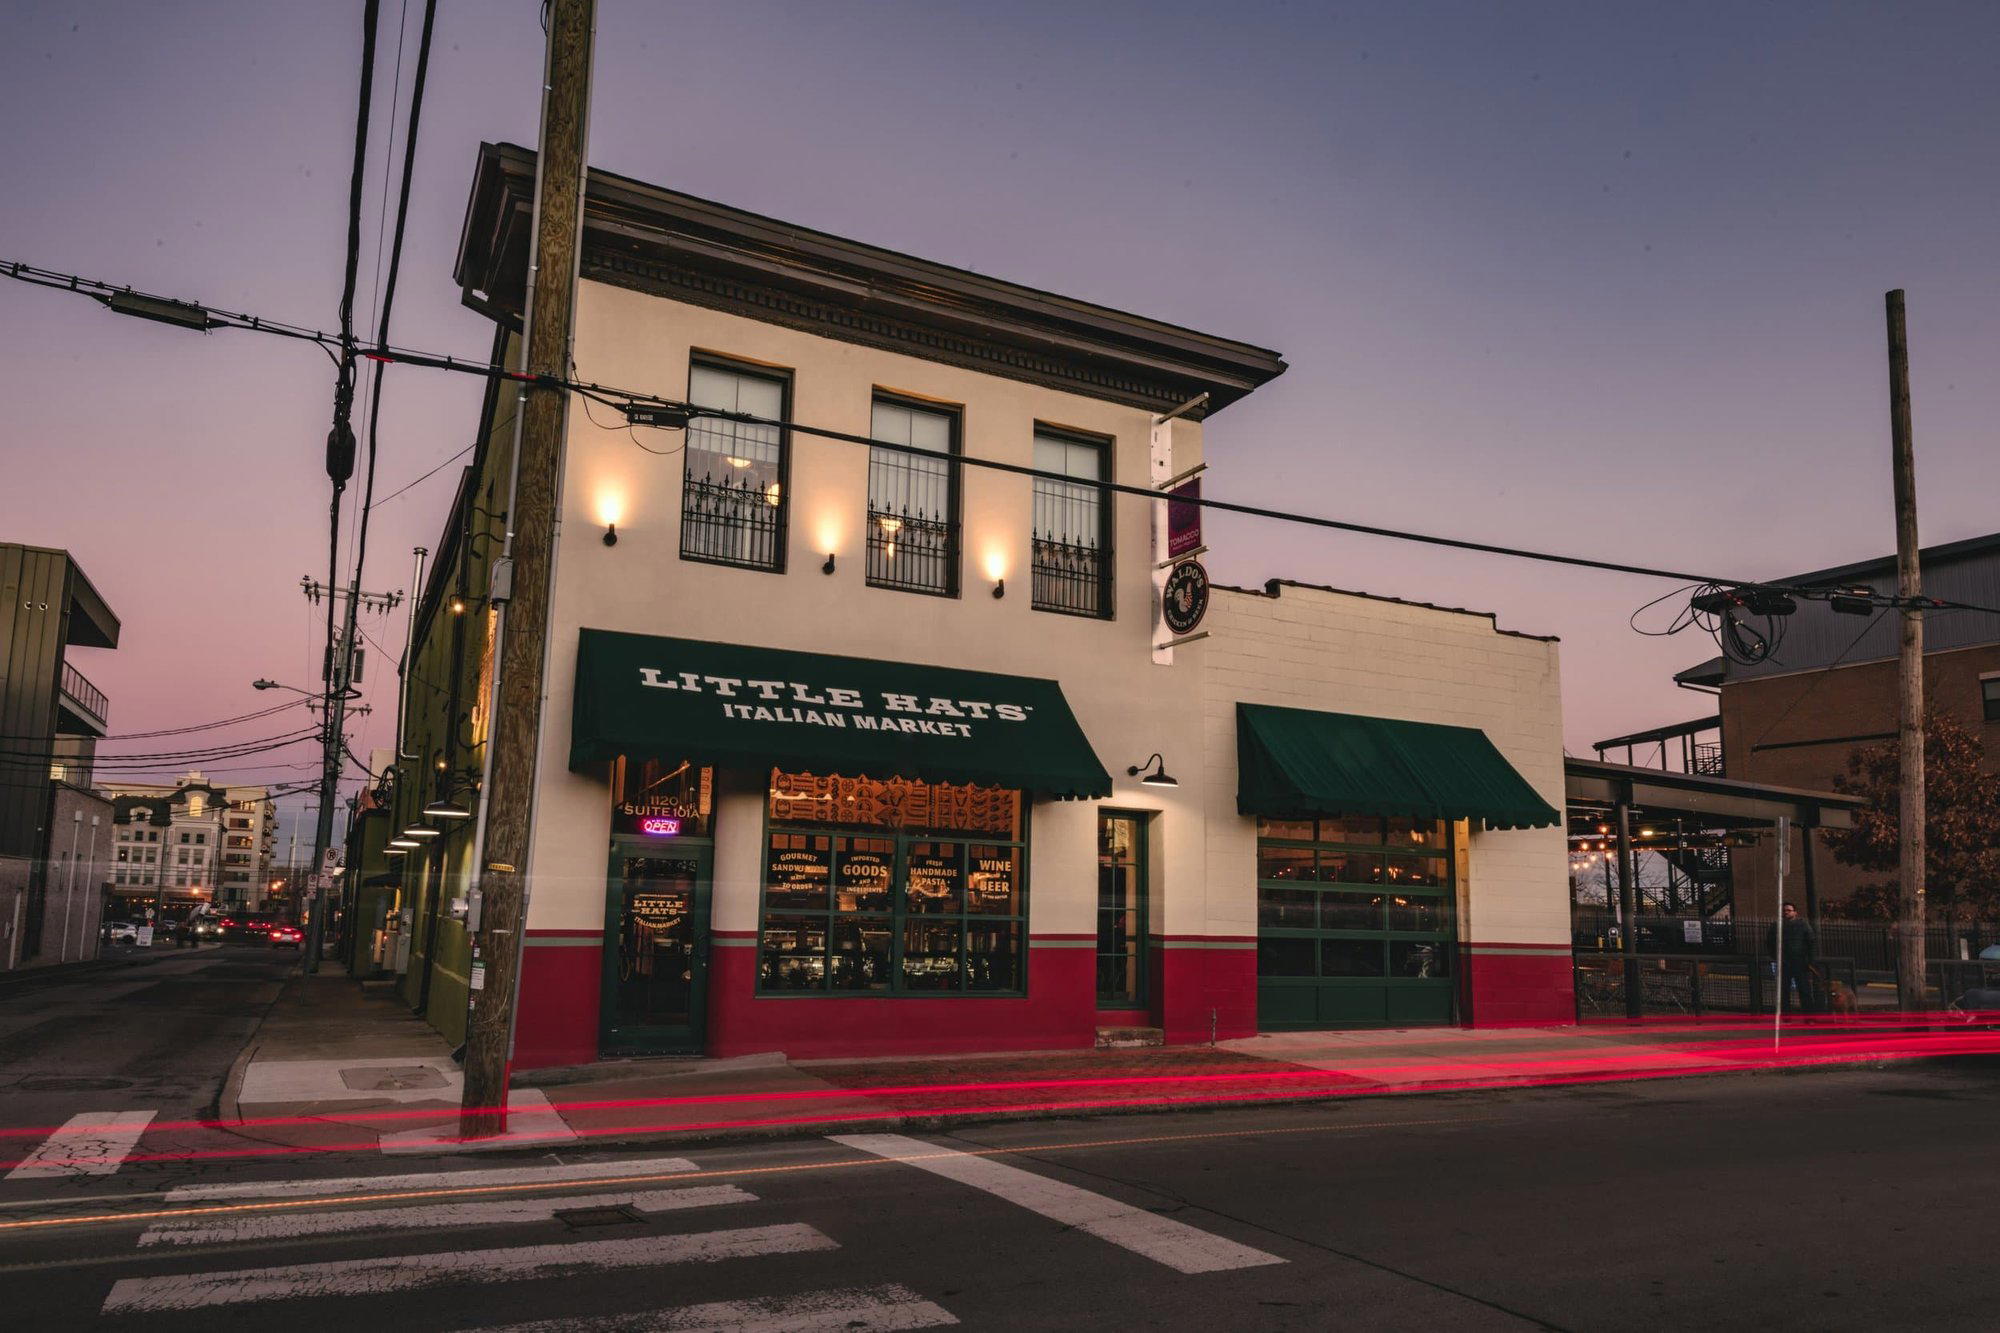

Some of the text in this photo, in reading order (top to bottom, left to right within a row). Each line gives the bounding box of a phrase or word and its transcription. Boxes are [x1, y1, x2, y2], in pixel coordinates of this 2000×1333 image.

[1166, 566, 1204, 599] WALDO'S
[639, 667, 1027, 721] LITTLE HATS
[723, 703, 972, 737] ITALIAN MARKET
[650, 795, 679, 806] 1120
[624, 805, 670, 817] SUITE
[644, 820, 677, 833] OPEN
[780, 852, 818, 863] GOURMET
[842, 864, 888, 877] GOODS
[910, 867, 958, 877] HANDMADE
[979, 860, 1012, 872] WINE
[921, 877, 946, 886] PASTA
[980, 881, 1010, 893] BEER
[633, 900, 683, 908] LITTLE
[641, 907, 678, 915] HATS
